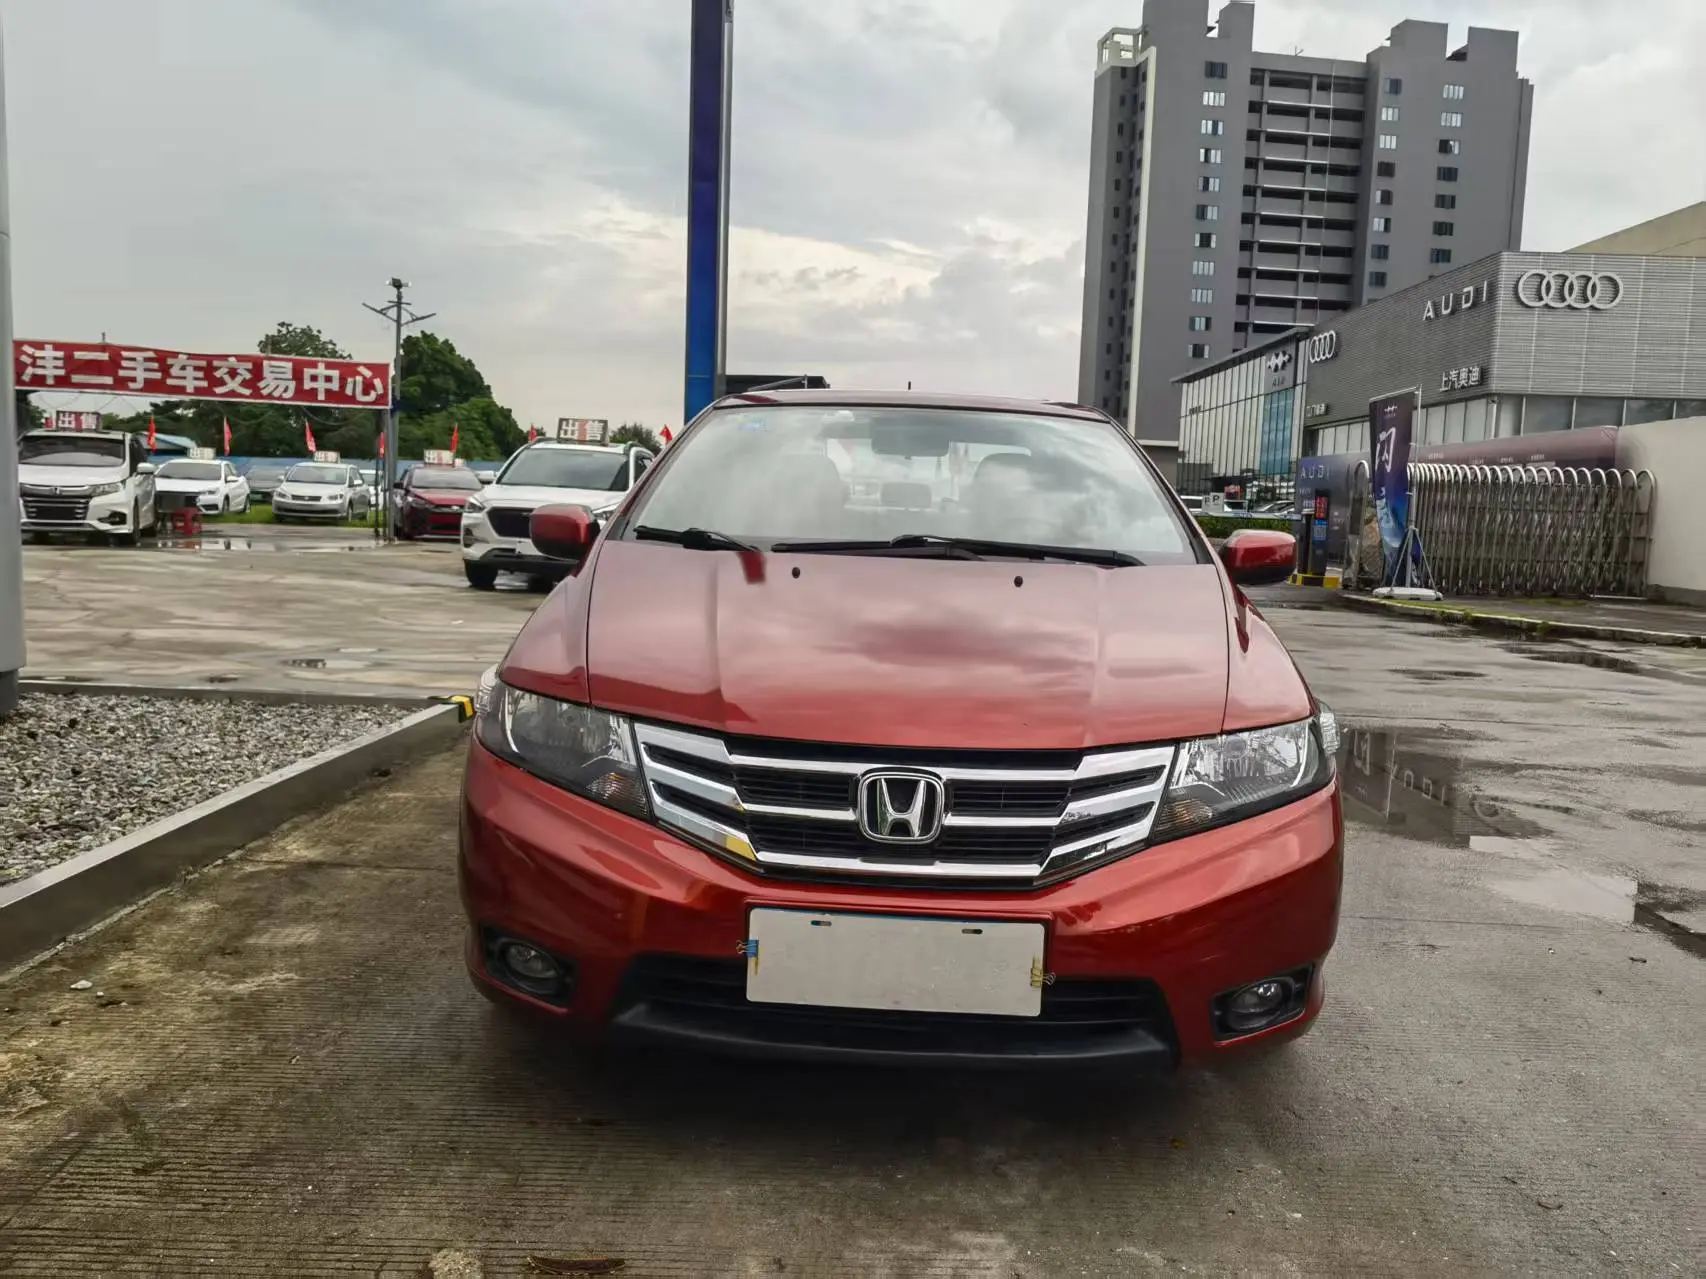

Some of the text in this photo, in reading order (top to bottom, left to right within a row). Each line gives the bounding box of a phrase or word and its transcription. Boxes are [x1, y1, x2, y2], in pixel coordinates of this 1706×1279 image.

[1422, 280, 1488, 321] AUDI
[19, 344, 384, 402] 沣二手车交易中心
[1440, 365, 1480, 392] 上汽奥迪
